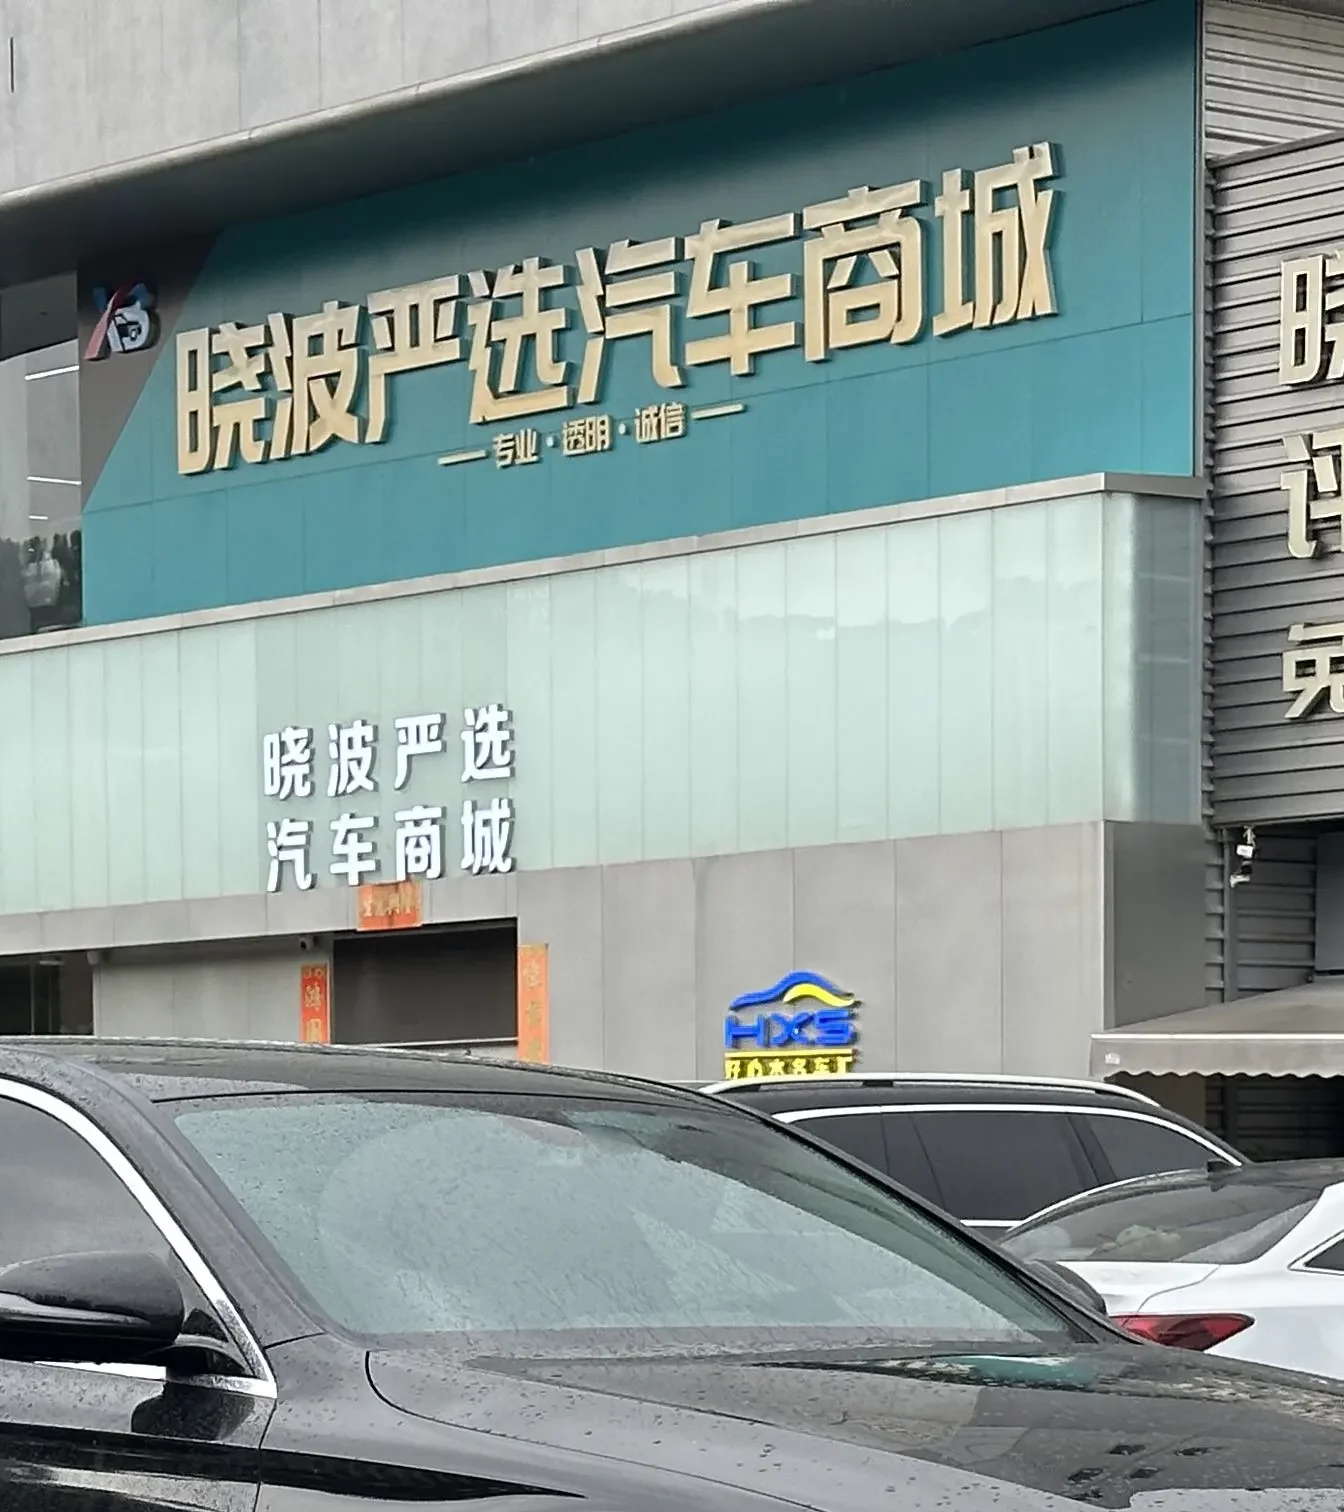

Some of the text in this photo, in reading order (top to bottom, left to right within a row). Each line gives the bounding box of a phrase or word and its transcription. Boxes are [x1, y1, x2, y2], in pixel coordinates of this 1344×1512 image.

[176, 140, 1062, 476] 晓波严选汽车商城
[263, 703, 515, 801] 晓波严选
[266, 798, 515, 893] 汽车商城
[724, 1009, 857, 1048] HXS
